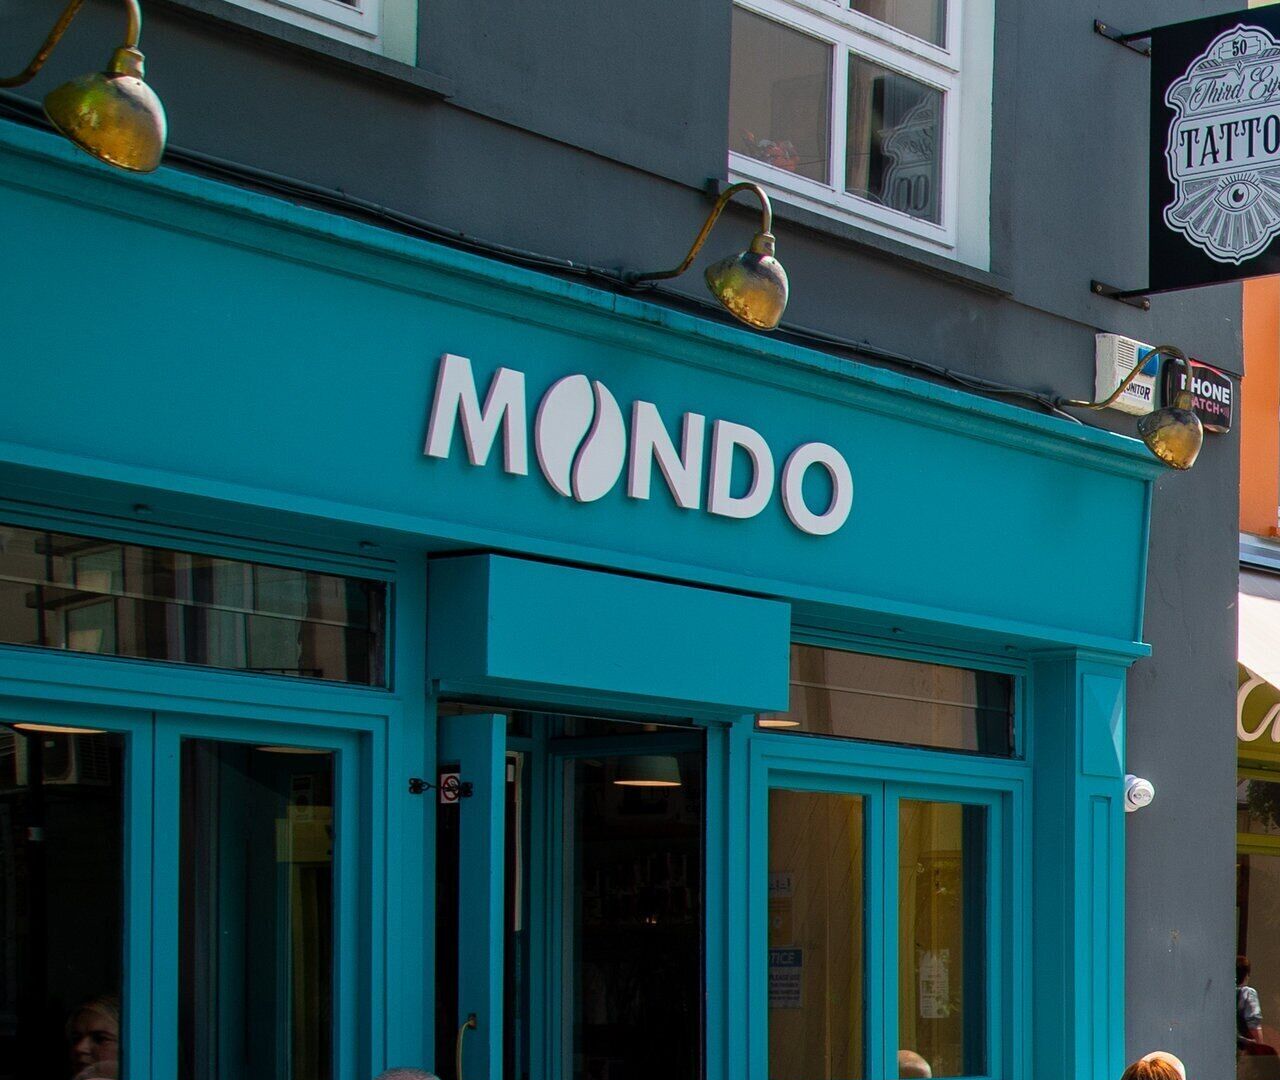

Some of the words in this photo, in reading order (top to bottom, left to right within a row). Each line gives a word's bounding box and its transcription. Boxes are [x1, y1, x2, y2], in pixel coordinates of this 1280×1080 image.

[1231, 38, 1248, 57] 50
[1189, 70, 1245, 111] Third
[1191, 396, 1220, 415] ATCH
[424, 353, 854, 536] MONDO
